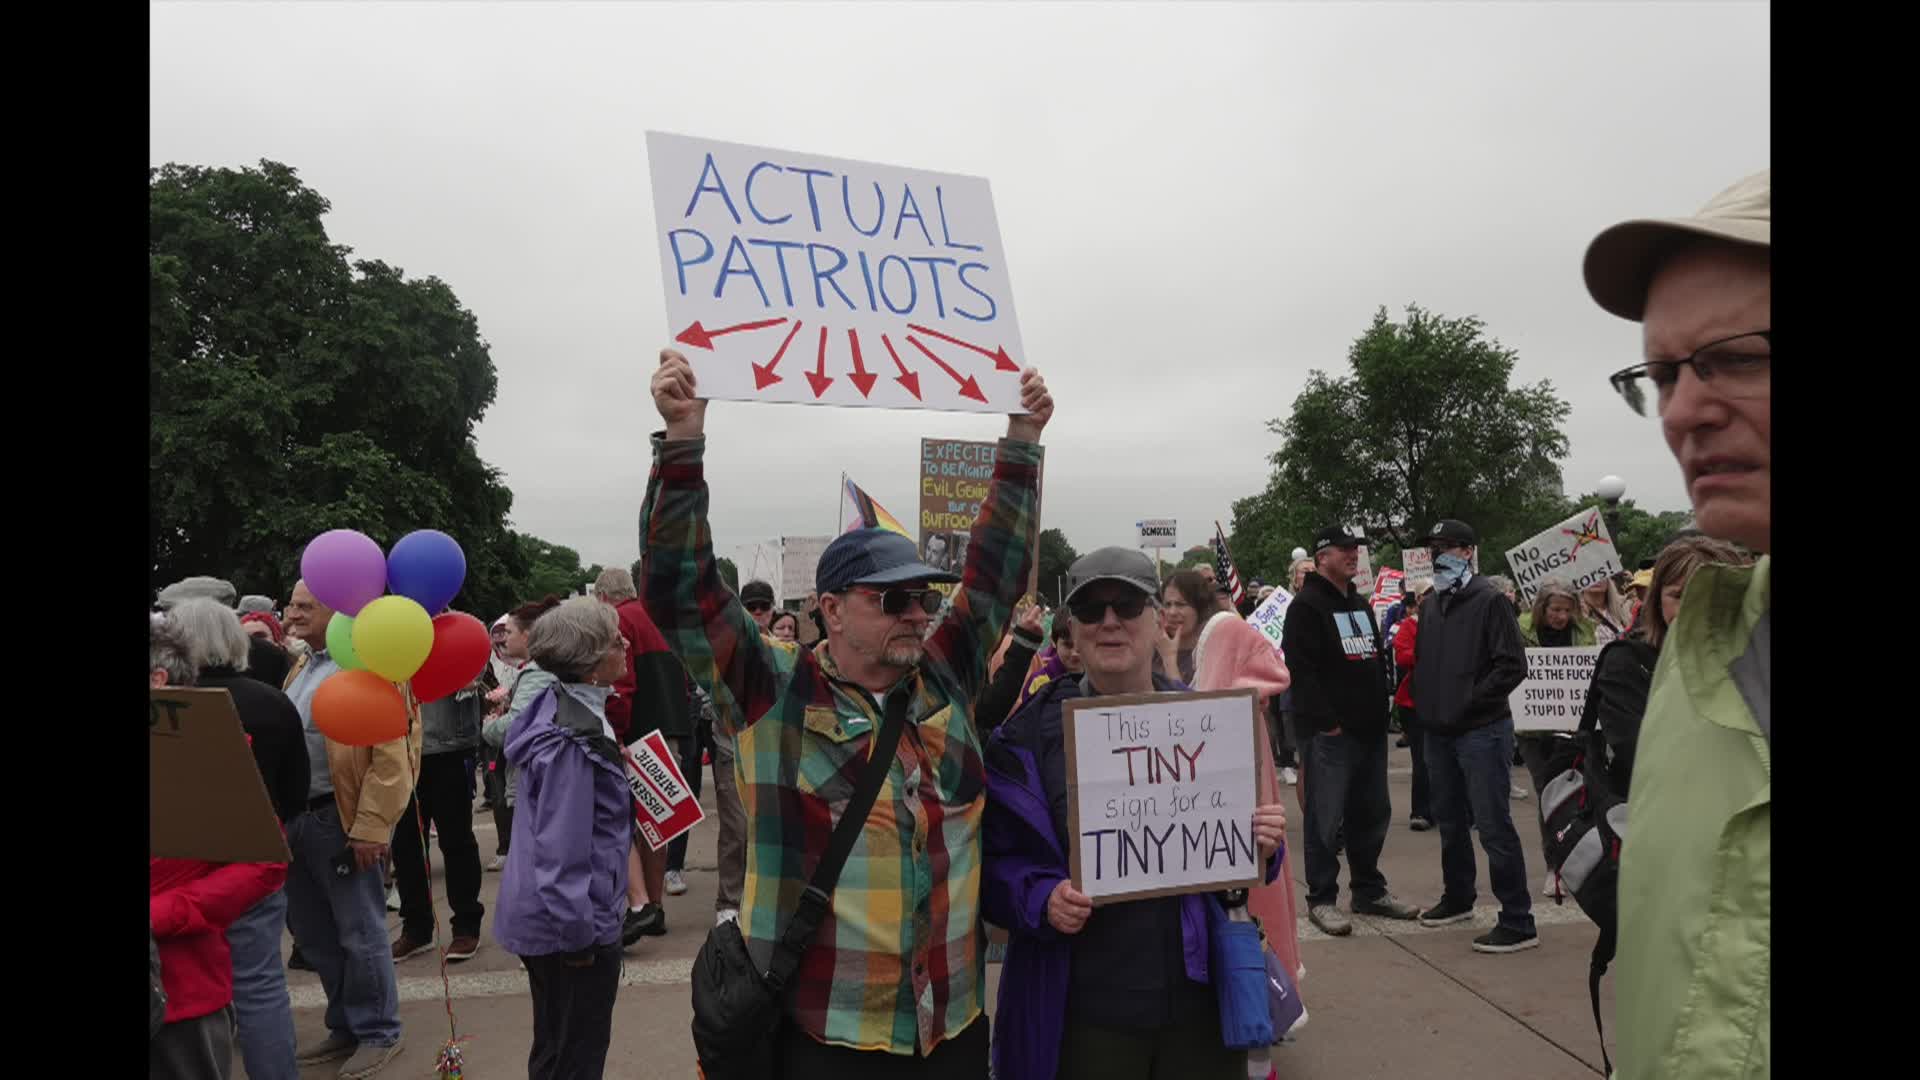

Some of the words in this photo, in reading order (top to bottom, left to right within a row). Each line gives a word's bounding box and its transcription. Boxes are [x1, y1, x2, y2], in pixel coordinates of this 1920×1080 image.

[684, 152, 983, 252] ACTUAL
[667, 229, 997, 321] PATRIOTS
[942, 462, 957, 476] BE
[1538, 655, 1598, 666] SENATORS
[1545, 669, 1564, 680] THE
[1524, 704, 1565, 716] STUPID
[1525, 688, 1564, 700] STUPID
[1570, 688, 1581, 700] IS
[1097, 711, 1150, 742] This
[1167, 713, 1185, 737] is
[1201, 712, 1216, 733] a
[635, 748, 682, 799] PATRIOTIC
[1111, 741, 1206, 786] TINY
[1105, 793, 1158, 832] sign
[1170, 786, 1200, 818] for
[1211, 790, 1228, 809] a
[1082, 823, 1175, 880] TINY
[1182, 814, 1256, 872] MAN
